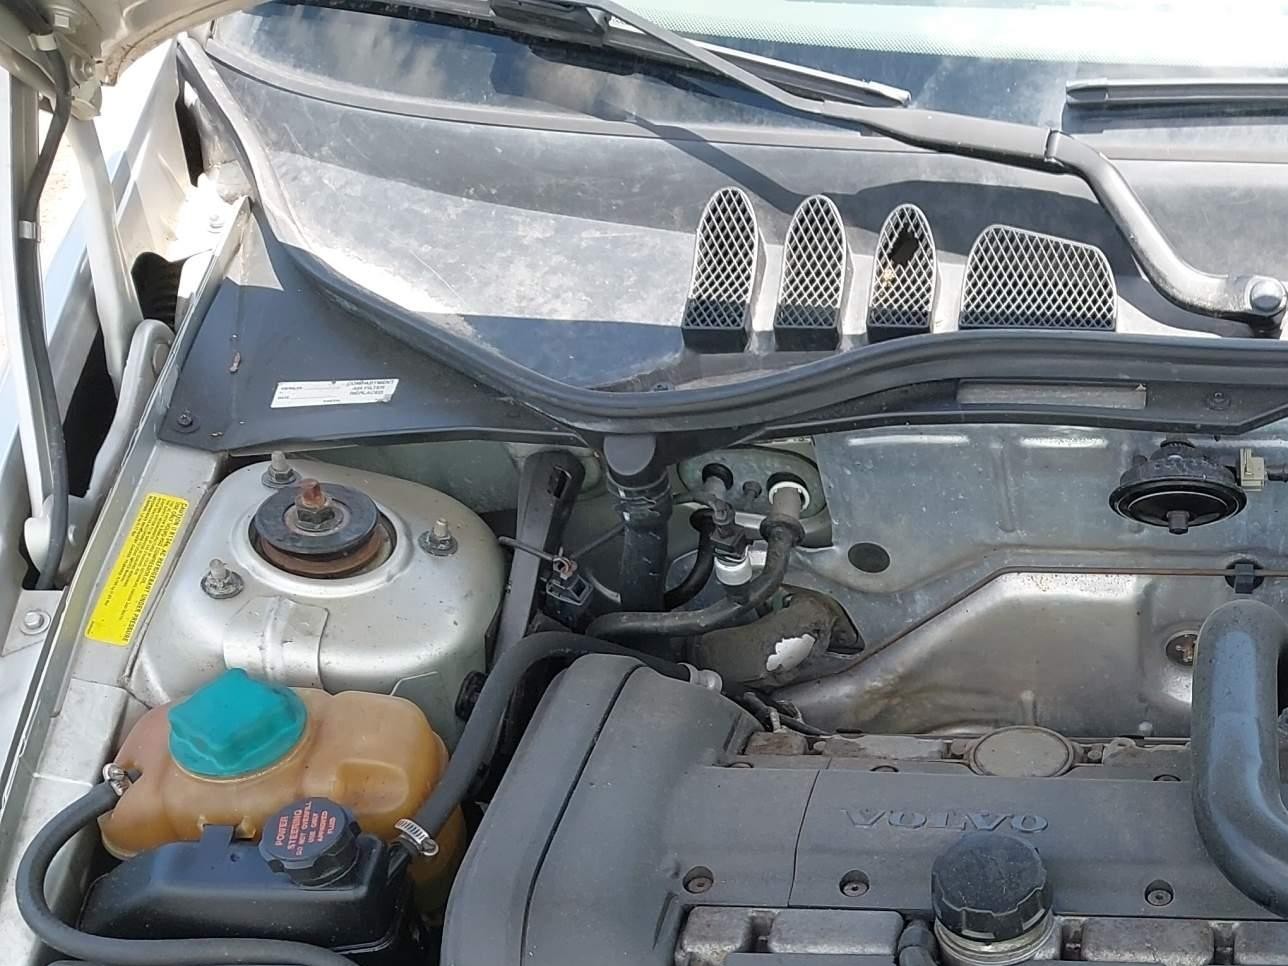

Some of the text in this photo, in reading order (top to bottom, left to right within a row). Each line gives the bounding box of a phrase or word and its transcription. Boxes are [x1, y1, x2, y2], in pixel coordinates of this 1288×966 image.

[134, 594, 147, 613] UNDER
[121, 613, 139, 641] PRESSURE
[275, 816, 288, 845] POWER
[287, 810, 303, 849] STEERING
[841, 809, 1048, 832] VOLVO
